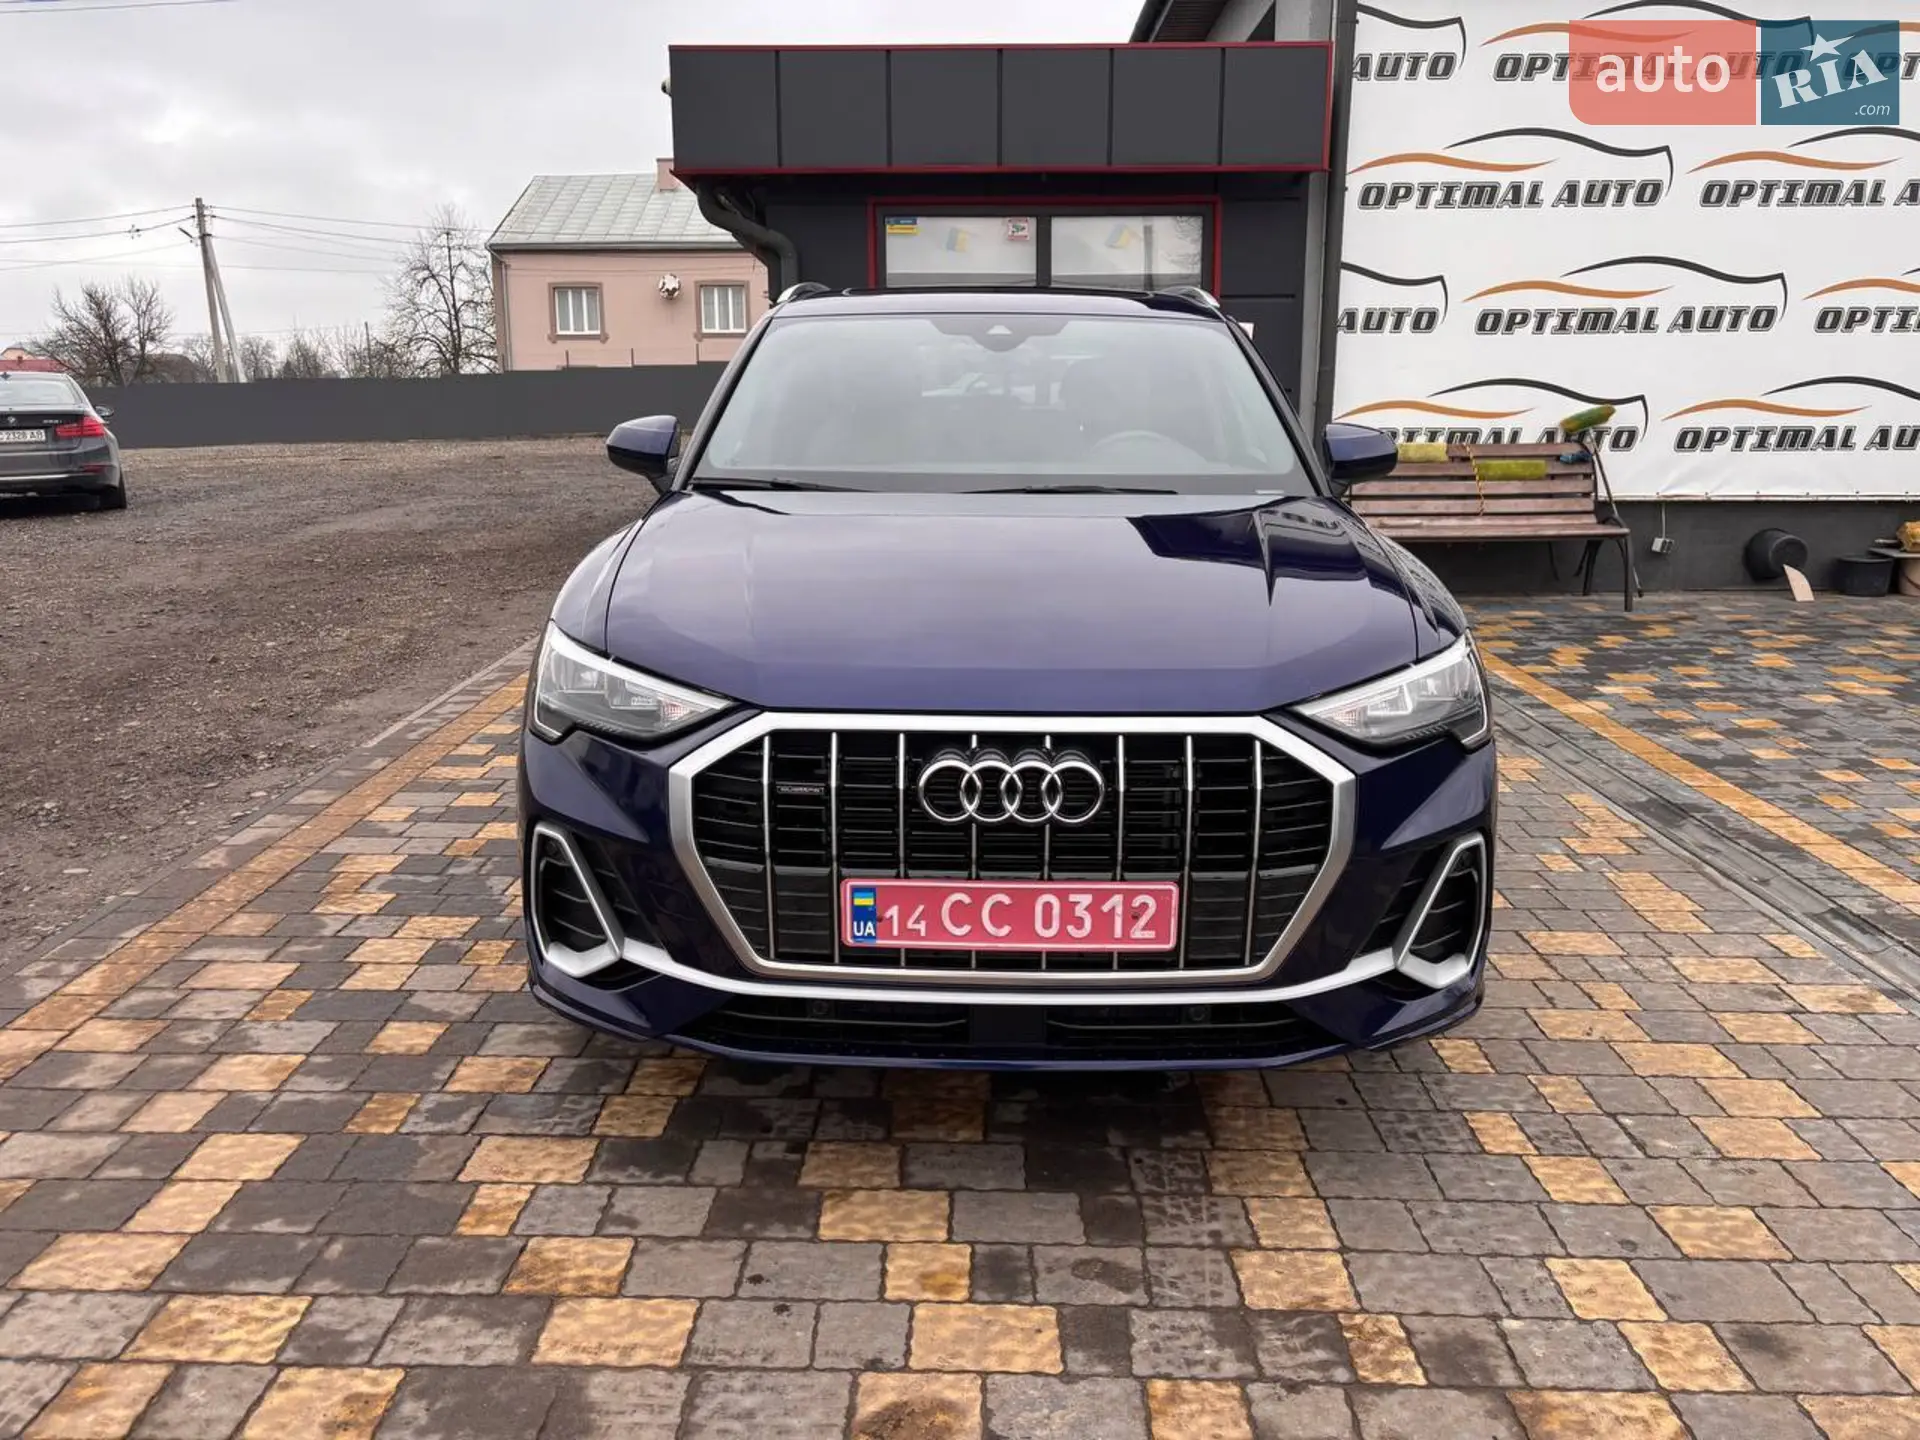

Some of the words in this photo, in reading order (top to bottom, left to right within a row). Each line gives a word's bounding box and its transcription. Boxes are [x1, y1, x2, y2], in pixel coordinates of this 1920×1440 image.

[1352, 52, 1457, 81] AUTO
[1358, 181, 1543, 209] OPTIMAL
[1551, 180, 1664, 208] AUTO
[1700, 180, 1886, 207] OPTIMAL
[1336, 307, 1439, 333] AUTO
[1475, 307, 1659, 335] OPTIMAL
[1667, 306, 1778, 332] AUTO
[1814, 306, 1920, 333] OPTI
[1674, 426, 1856, 452] OPTIMAL
[853, 920, 875, 936] UA
[884, 905, 926, 936] 14
[941, 893, 1012, 937] CC
[1034, 894, 1157, 939] 0312
